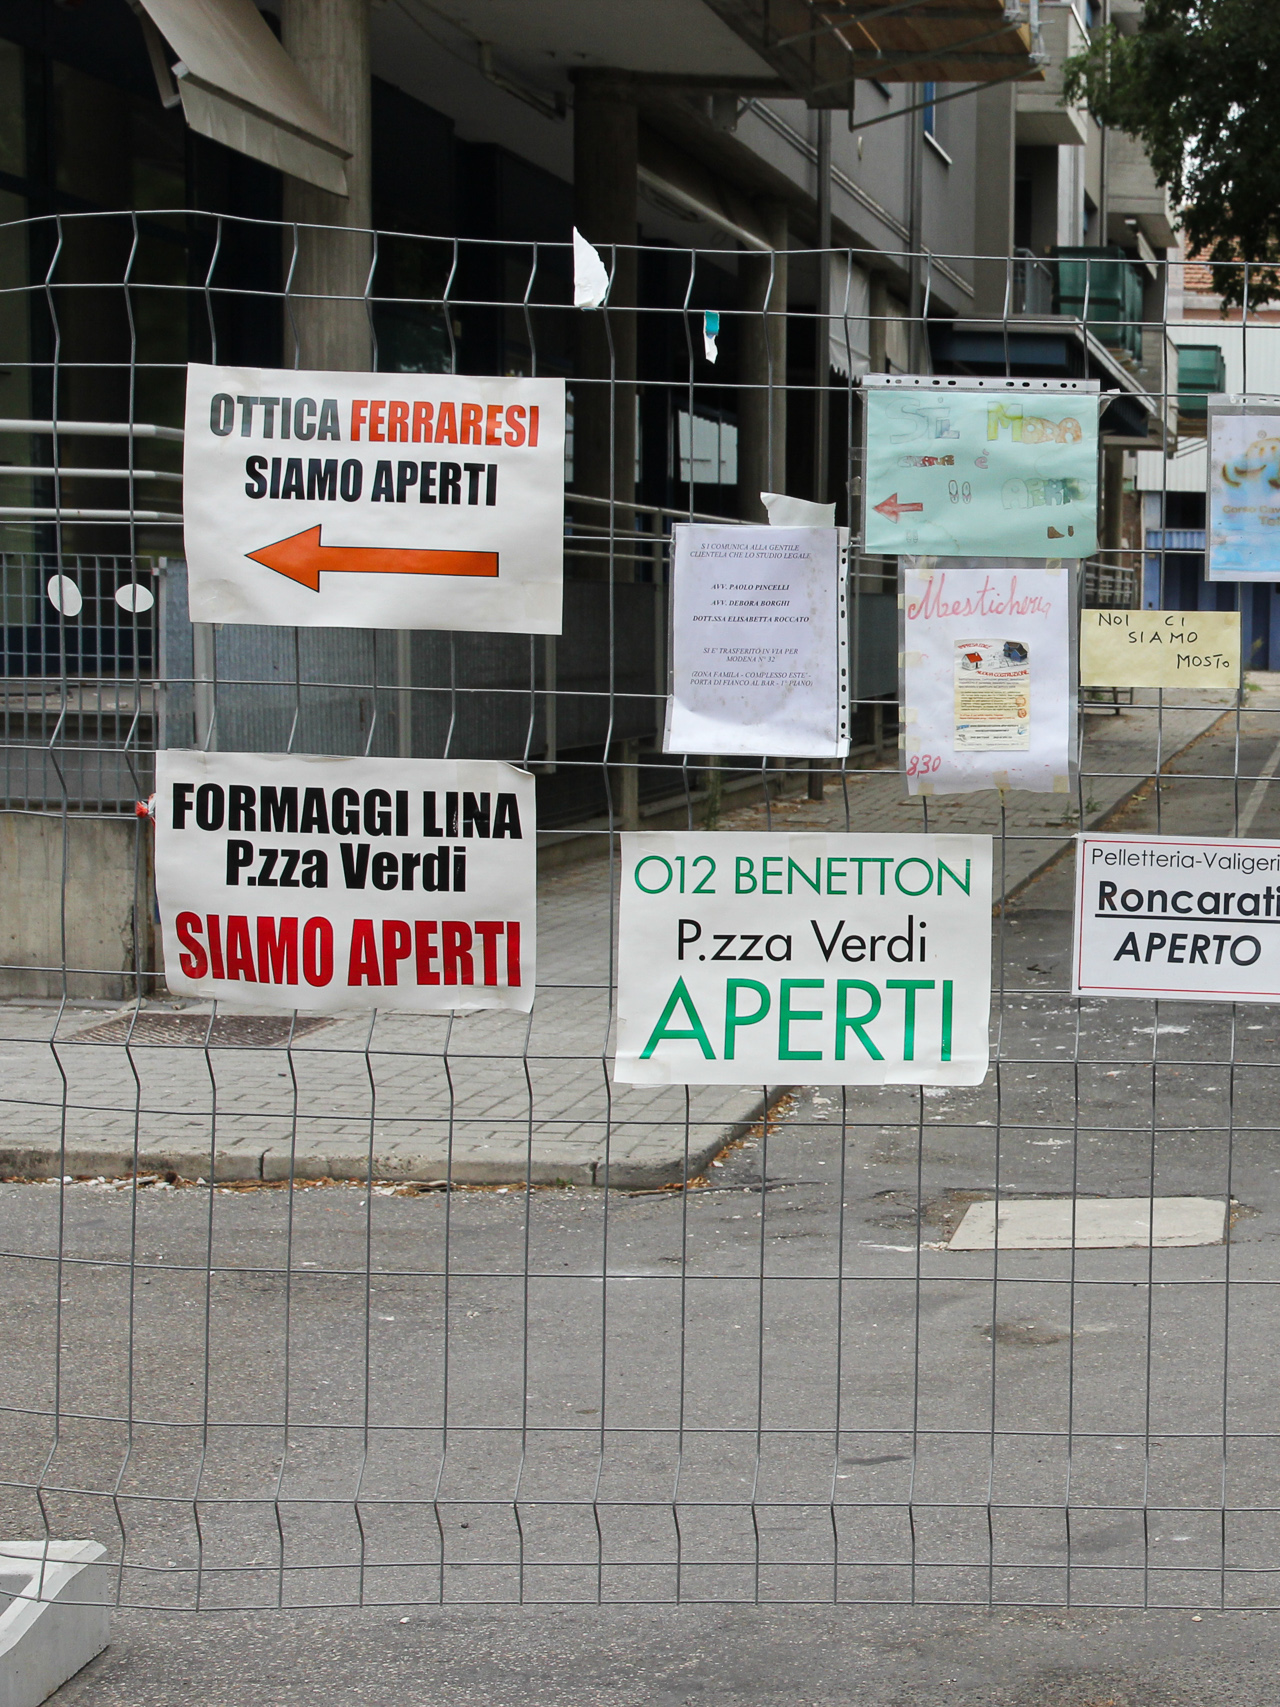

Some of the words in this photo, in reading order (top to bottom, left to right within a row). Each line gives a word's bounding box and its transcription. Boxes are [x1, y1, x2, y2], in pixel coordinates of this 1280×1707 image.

[209, 393, 341, 441] OTTICA
[350, 399, 540, 448] FERRARESI
[244, 455, 363, 502] SIAMO
[370, 460, 499, 506] APERTI
[711, 543, 749, 551] COMUNICA
[1098, 612, 1129, 627] NOI
[1165, 615, 1185, 627] CI
[1128, 631, 1198, 644] SIAMO
[172, 782, 409, 837] FORMAGGI
[423, 791, 523, 839] LINA
[225, 839, 328, 889] P.zza
[340, 842, 467, 892] Verdi
[735, 856, 971, 897] BENETTON
[175, 910, 334, 987] SIAMO
[347, 918, 521, 987] APERTI
[678, 918, 792, 962] P.zza
[810, 914, 927, 963] Verdi
[1113, 931, 1261, 967] APERTO
[638, 975, 954, 1062] APERTI
